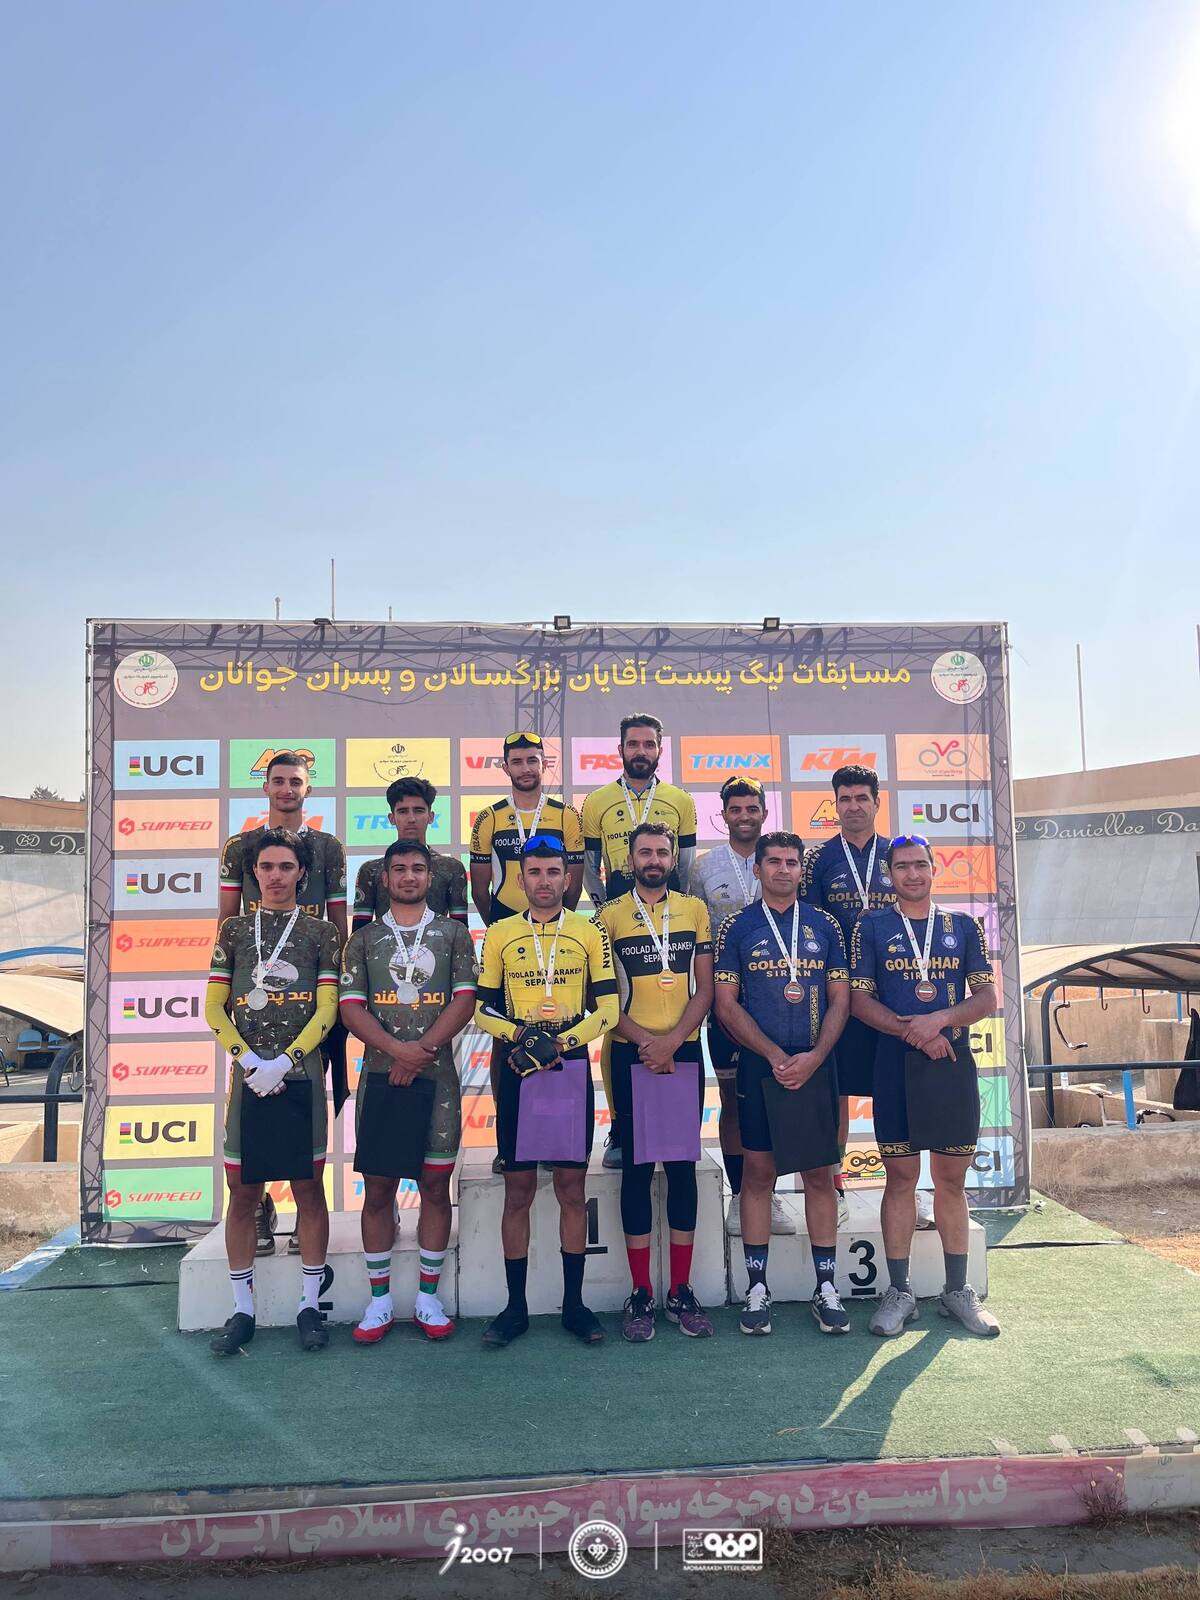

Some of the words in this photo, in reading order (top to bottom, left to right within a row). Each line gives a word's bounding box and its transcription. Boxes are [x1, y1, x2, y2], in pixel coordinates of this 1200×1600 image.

[199, 660, 298, 693] جوانان
[306, 661, 392, 696] پسران
[399, 668, 417, 692] و
[423, 658, 561, 693] بزرگسالان
[568, 658, 648, 693] آقایان
[654, 664, 733, 695] پیست
[739, 658, 785, 691] لیگ
[792, 661, 911, 691] مسابقات
[143, 755, 204, 776] UCI
[689, 752, 773, 769] TRINX
[925, 803, 980, 823] UCI
[137, 821, 213, 831] SUNPEED
[1033, 812, 1147, 840] Daniellee
[140, 872, 202, 894] UCI
[842, 901, 885, 910] SIRAN
[135, 937, 212, 948] SUNPEED
[588, 917, 611, 969] SEPAHAN
[621, 945, 651, 956] FOOLAD
[643, 953, 676, 963] SEPAAN
[748, 959, 825, 971] GOLGHAR
[508, 971, 535, 979] FOOLAD
[525, 977, 566, 987] SEPAAN
[766, 970, 812, 978] SIRAN
[903, 971, 945, 980] SIRAN
[138, 996, 199, 1019] UCI
[131, 1064, 208, 1076] SUNPEED
[134, 1120, 197, 1144] UCI
[971, 1150, 1001, 1172] CI
[745, 1256, 764, 1271] sky
[849, 1239, 878, 1287] 3
[160, 1513, 281, 1556] ایران
[289, 1503, 416, 1553] اسلامی
